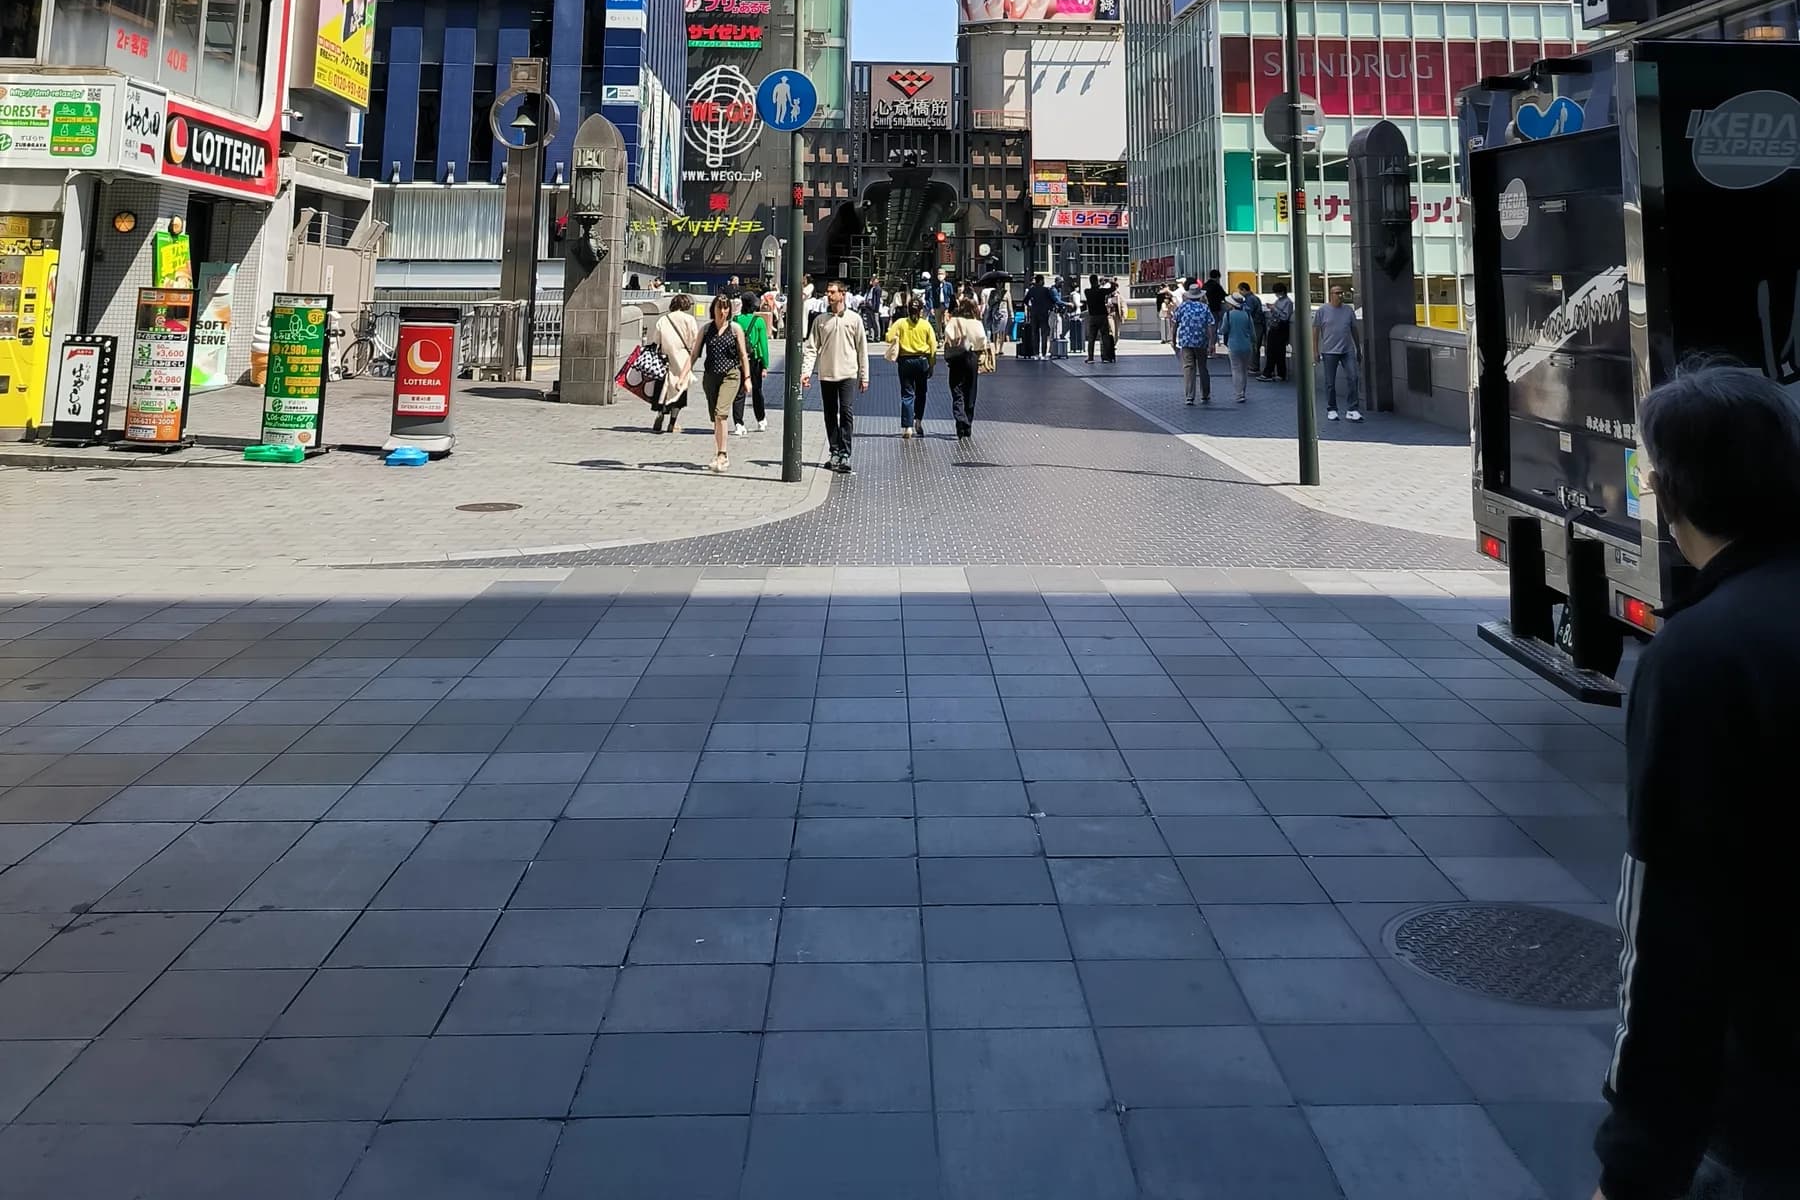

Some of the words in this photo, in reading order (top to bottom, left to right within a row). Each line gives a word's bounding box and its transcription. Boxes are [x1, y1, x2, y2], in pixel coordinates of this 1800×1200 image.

[688, 24, 763, 40] サイゼリヤ
[192, 127, 267, 178] LOTTERIA
[1699, 140, 1800, 156] EXPRES
[195, 320, 228, 331] SOFT
[194, 335, 227, 345] SERVE
[403, 378, 441, 386] LOTTERIA
